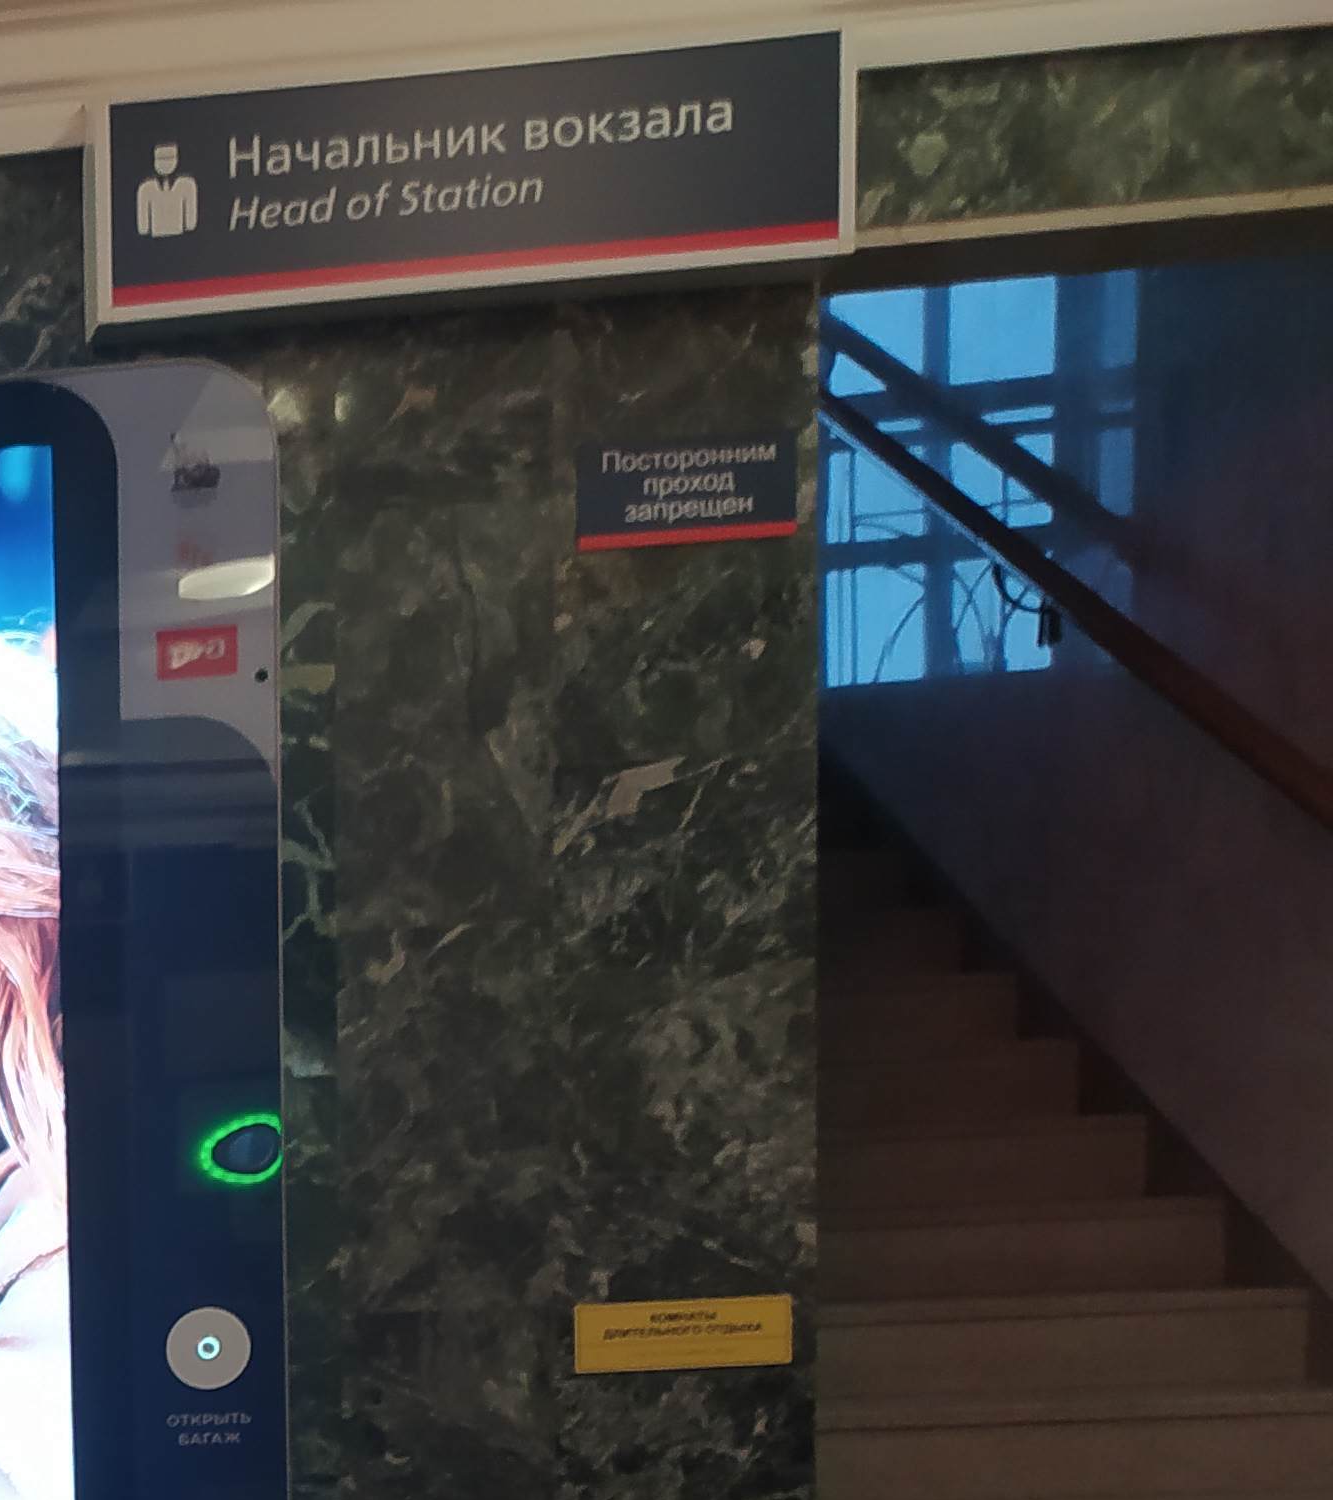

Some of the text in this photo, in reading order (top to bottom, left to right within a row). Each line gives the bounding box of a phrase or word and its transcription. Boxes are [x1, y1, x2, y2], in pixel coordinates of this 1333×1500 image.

[229, 97, 733, 178] Начальник вокзала
[229, 173, 545, 232] Head of Station
[601, 443, 777, 474] Посторонним
[643, 471, 735, 498] проход
[624, 495, 754, 524] запрещен
[166, 1412, 252, 1428] ОТКРЫТЬ
[178, 1432, 241, 1446] БАГАЖ
